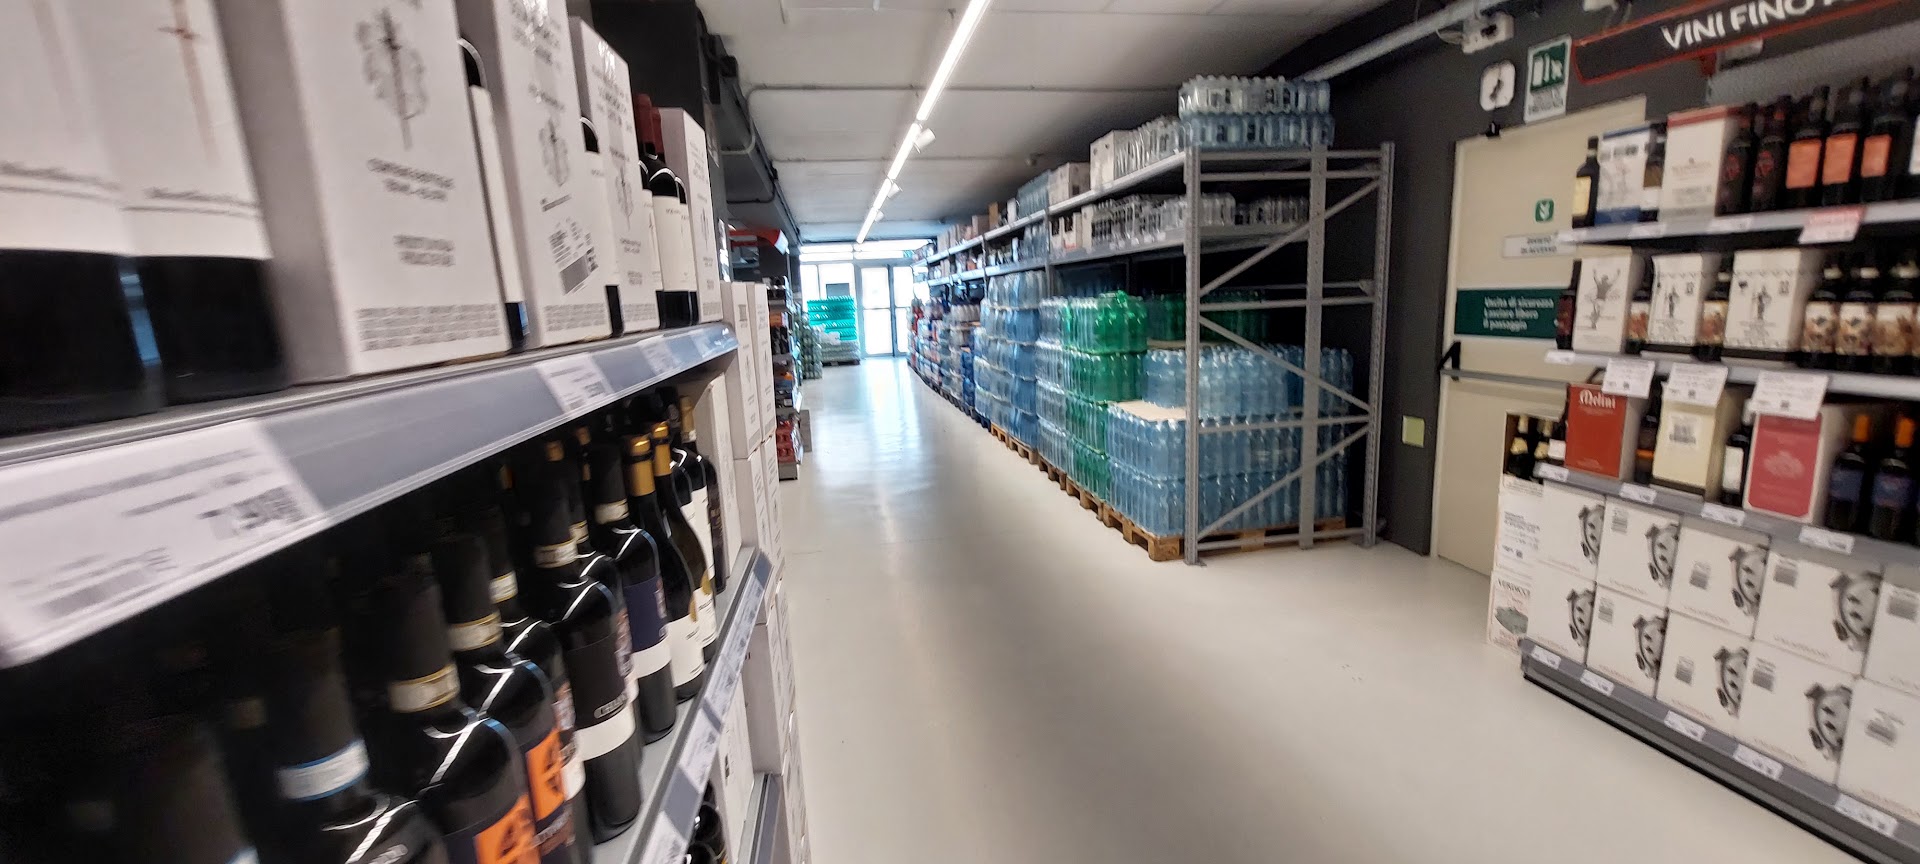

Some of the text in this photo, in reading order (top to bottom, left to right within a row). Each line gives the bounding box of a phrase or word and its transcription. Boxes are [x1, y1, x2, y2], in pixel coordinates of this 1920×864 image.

[1660, 0, 1816, 50] VINI FINO
[1484, 296, 1554, 309] Uscita di sicurezza
[1490, 319, 1528, 332] passaggio
[1580, 389, 1616, 410] Melini
